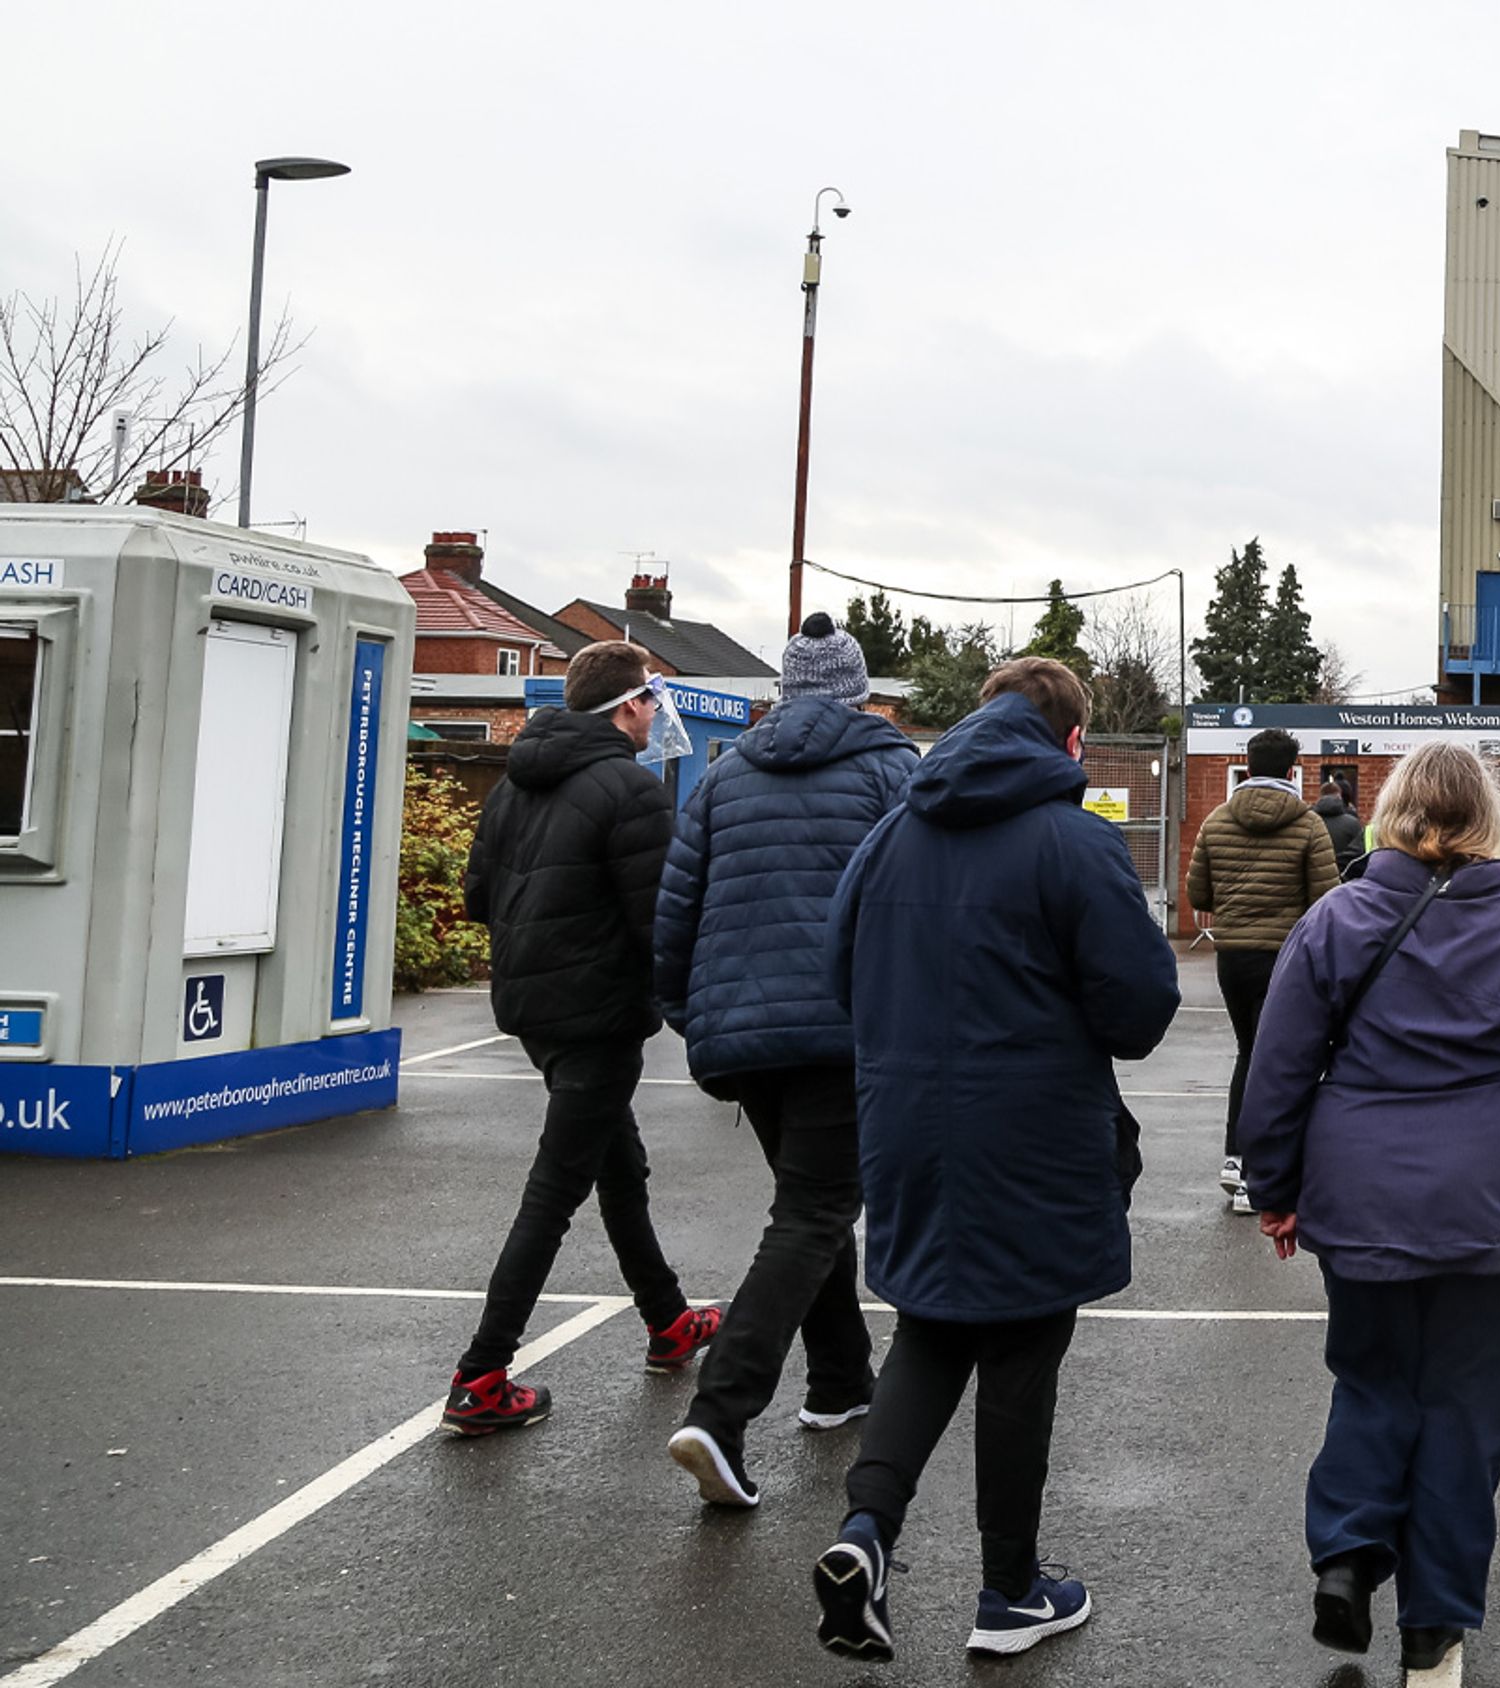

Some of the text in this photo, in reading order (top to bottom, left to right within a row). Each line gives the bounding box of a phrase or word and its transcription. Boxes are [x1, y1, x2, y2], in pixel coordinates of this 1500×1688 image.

[217, 573, 308, 608] CARD/CASH
[1339, 712, 1391, 725] Weston
[1393, 712, 1443, 726] Homes
[1333, 744, 1346, 754] 24
[343, 669, 373, 1005] PETERBOROUGH RECLINER CENTRE
[0, 1087, 72, 1131] .uk
[143, 1058, 392, 1121] www.peterboroughreclinercentre.co.uk
